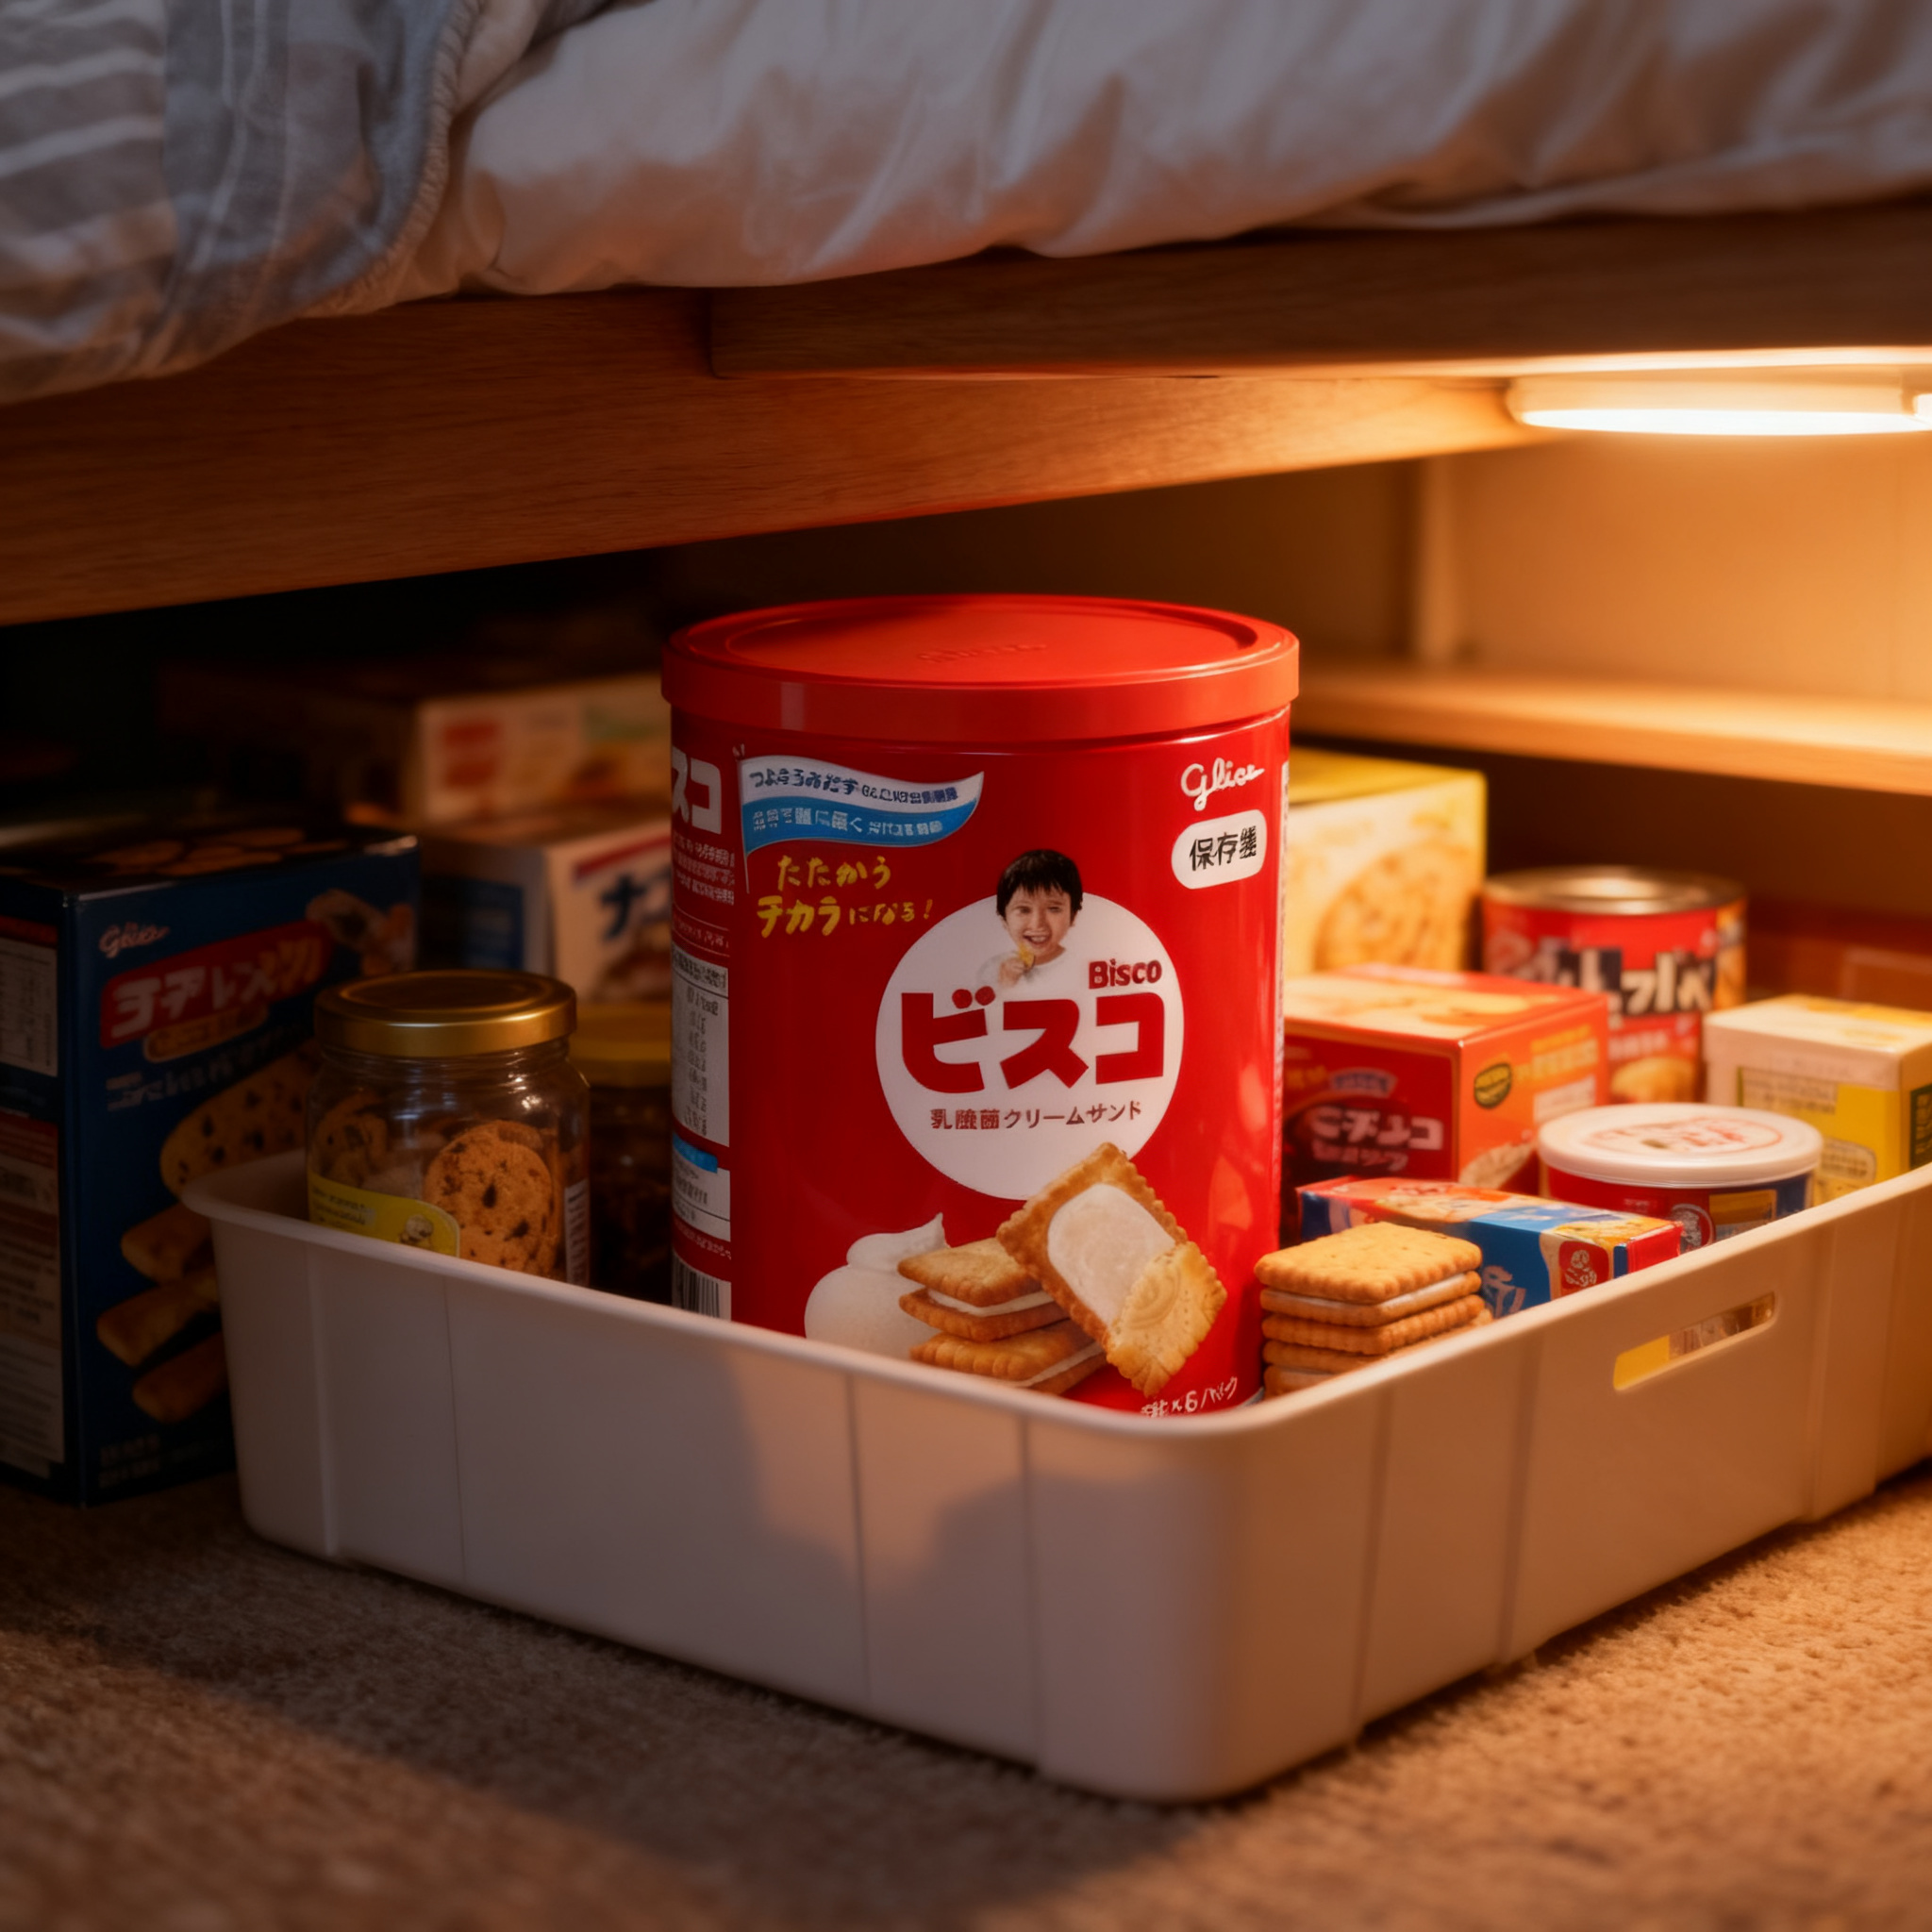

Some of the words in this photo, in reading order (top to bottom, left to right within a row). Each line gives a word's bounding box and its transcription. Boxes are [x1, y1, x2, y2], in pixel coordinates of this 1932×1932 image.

[777, 855, 891, 891] たたかう
[1089, 958, 1163, 990] Bisco
[901, 986, 1165, 1094] ビスコ
